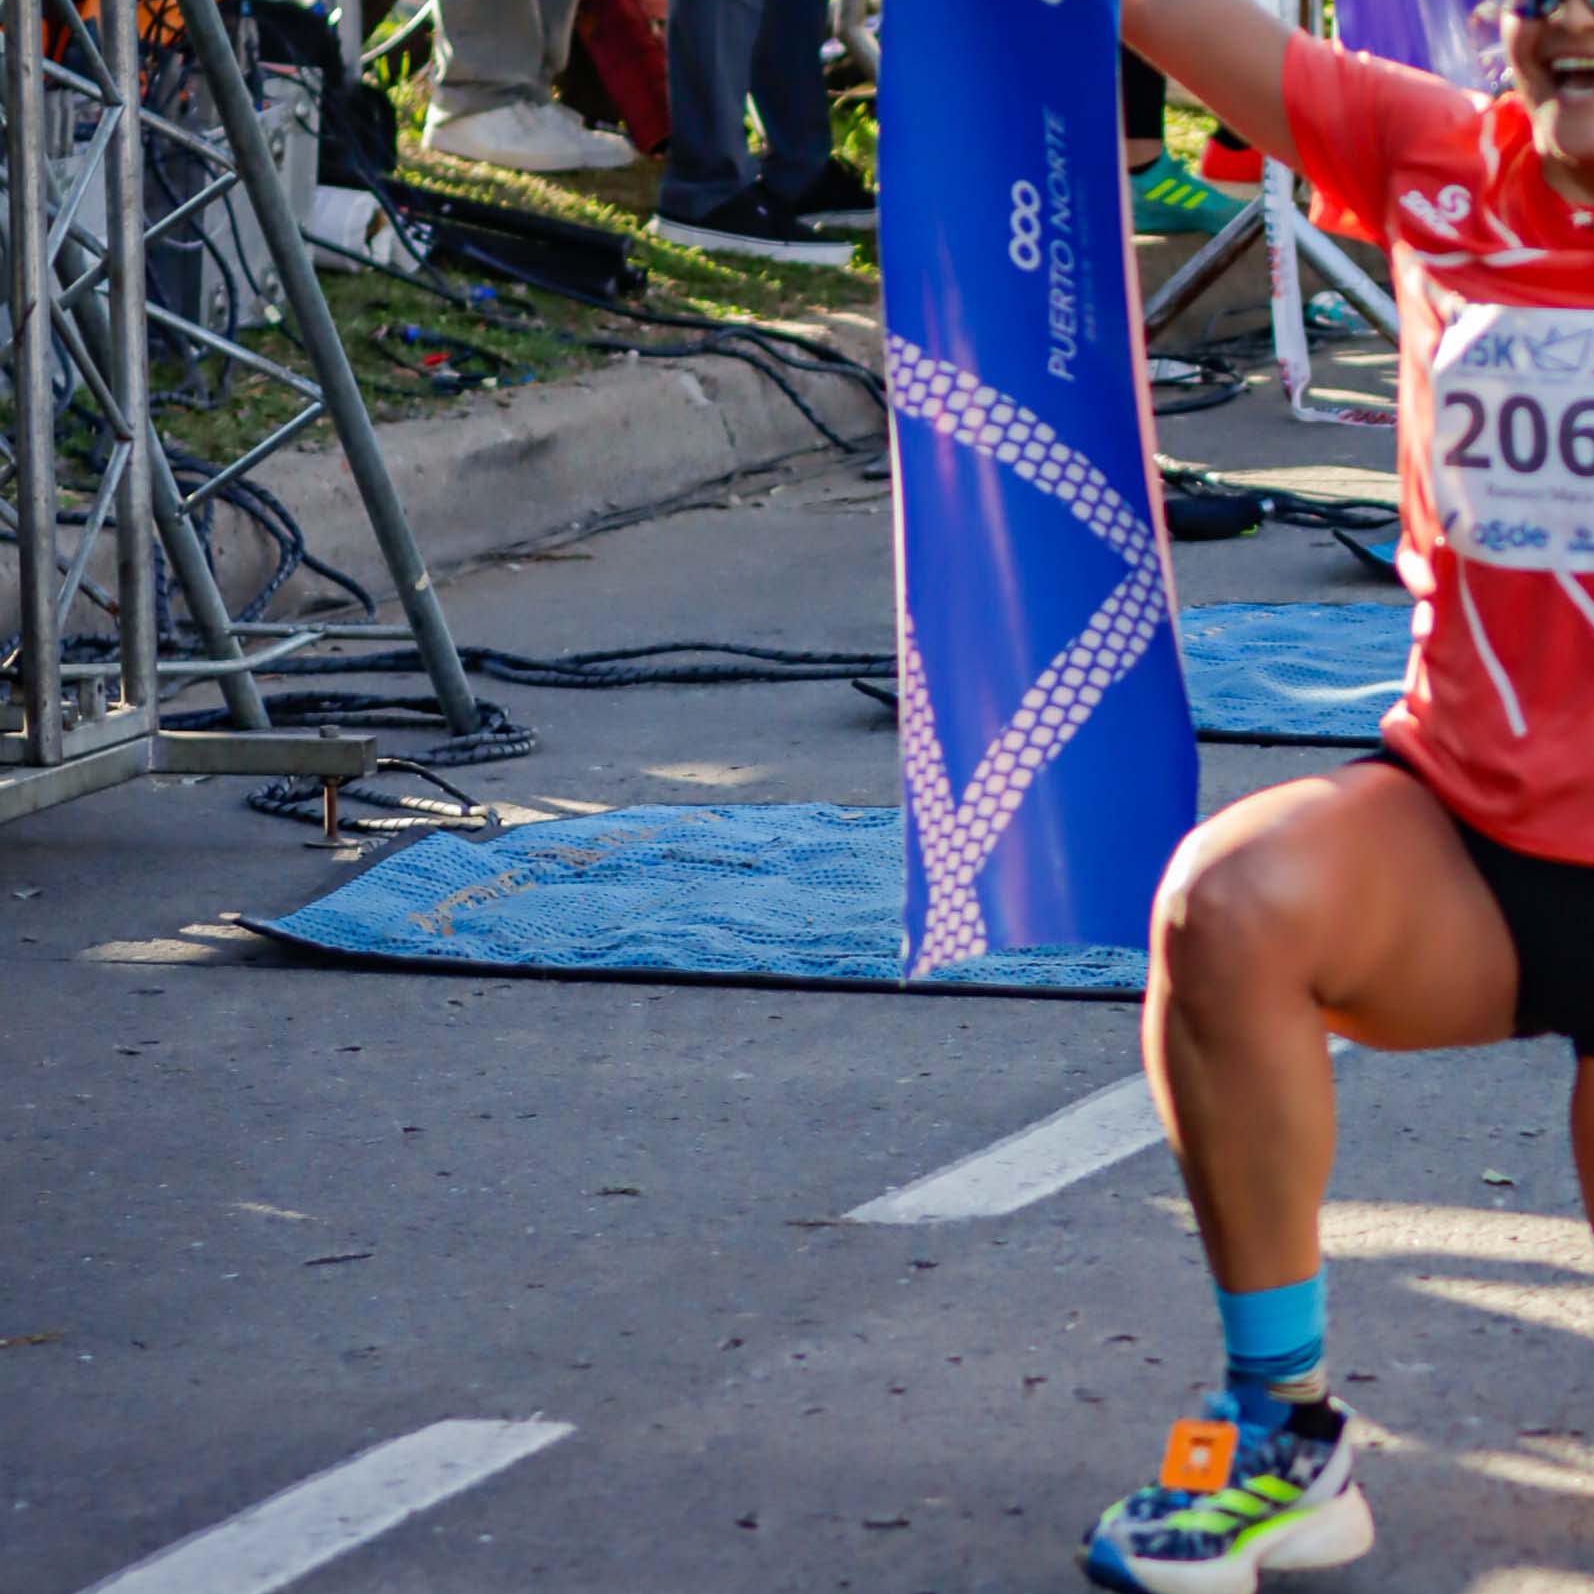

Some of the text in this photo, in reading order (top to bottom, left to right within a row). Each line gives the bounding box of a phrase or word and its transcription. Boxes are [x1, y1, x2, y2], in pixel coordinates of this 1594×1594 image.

[1044, 102, 1077, 383] PUERTO NORTE
[1460, 331, 1518, 371] 5K
